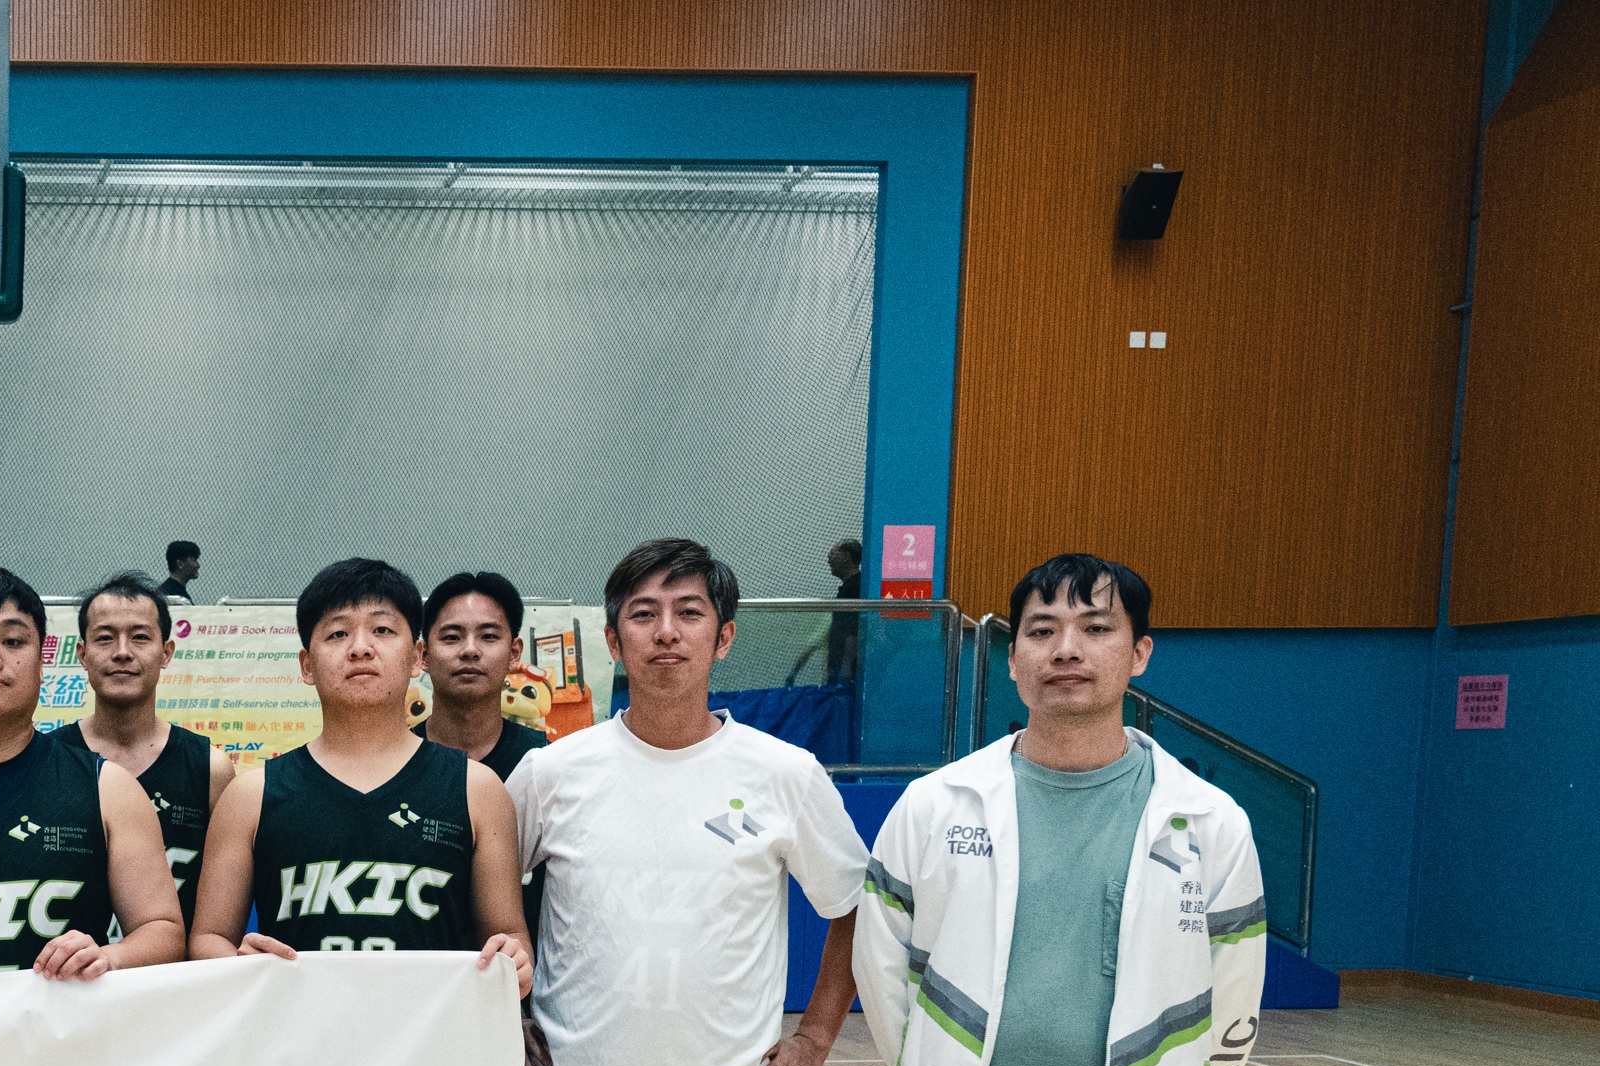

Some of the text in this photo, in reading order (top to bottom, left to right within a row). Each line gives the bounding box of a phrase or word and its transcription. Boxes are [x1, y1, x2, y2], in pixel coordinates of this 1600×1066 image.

[901, 532, 916, 556] 2
[241, 625, 267, 635] Book
[218, 650, 245, 660] Enrol
[246, 651, 256, 660] in
[196, 674, 241, 684] Purchase
[243, 675, 253, 684] of
[255, 675, 295, 686] monthly
[222, 699, 279, 709] Self-service
[947, 840, 993, 858] TEAM
[276, 860, 454, 922] HKIC
[1179, 899, 1205, 914] 建造
[1177, 918, 1204, 933] 學院
